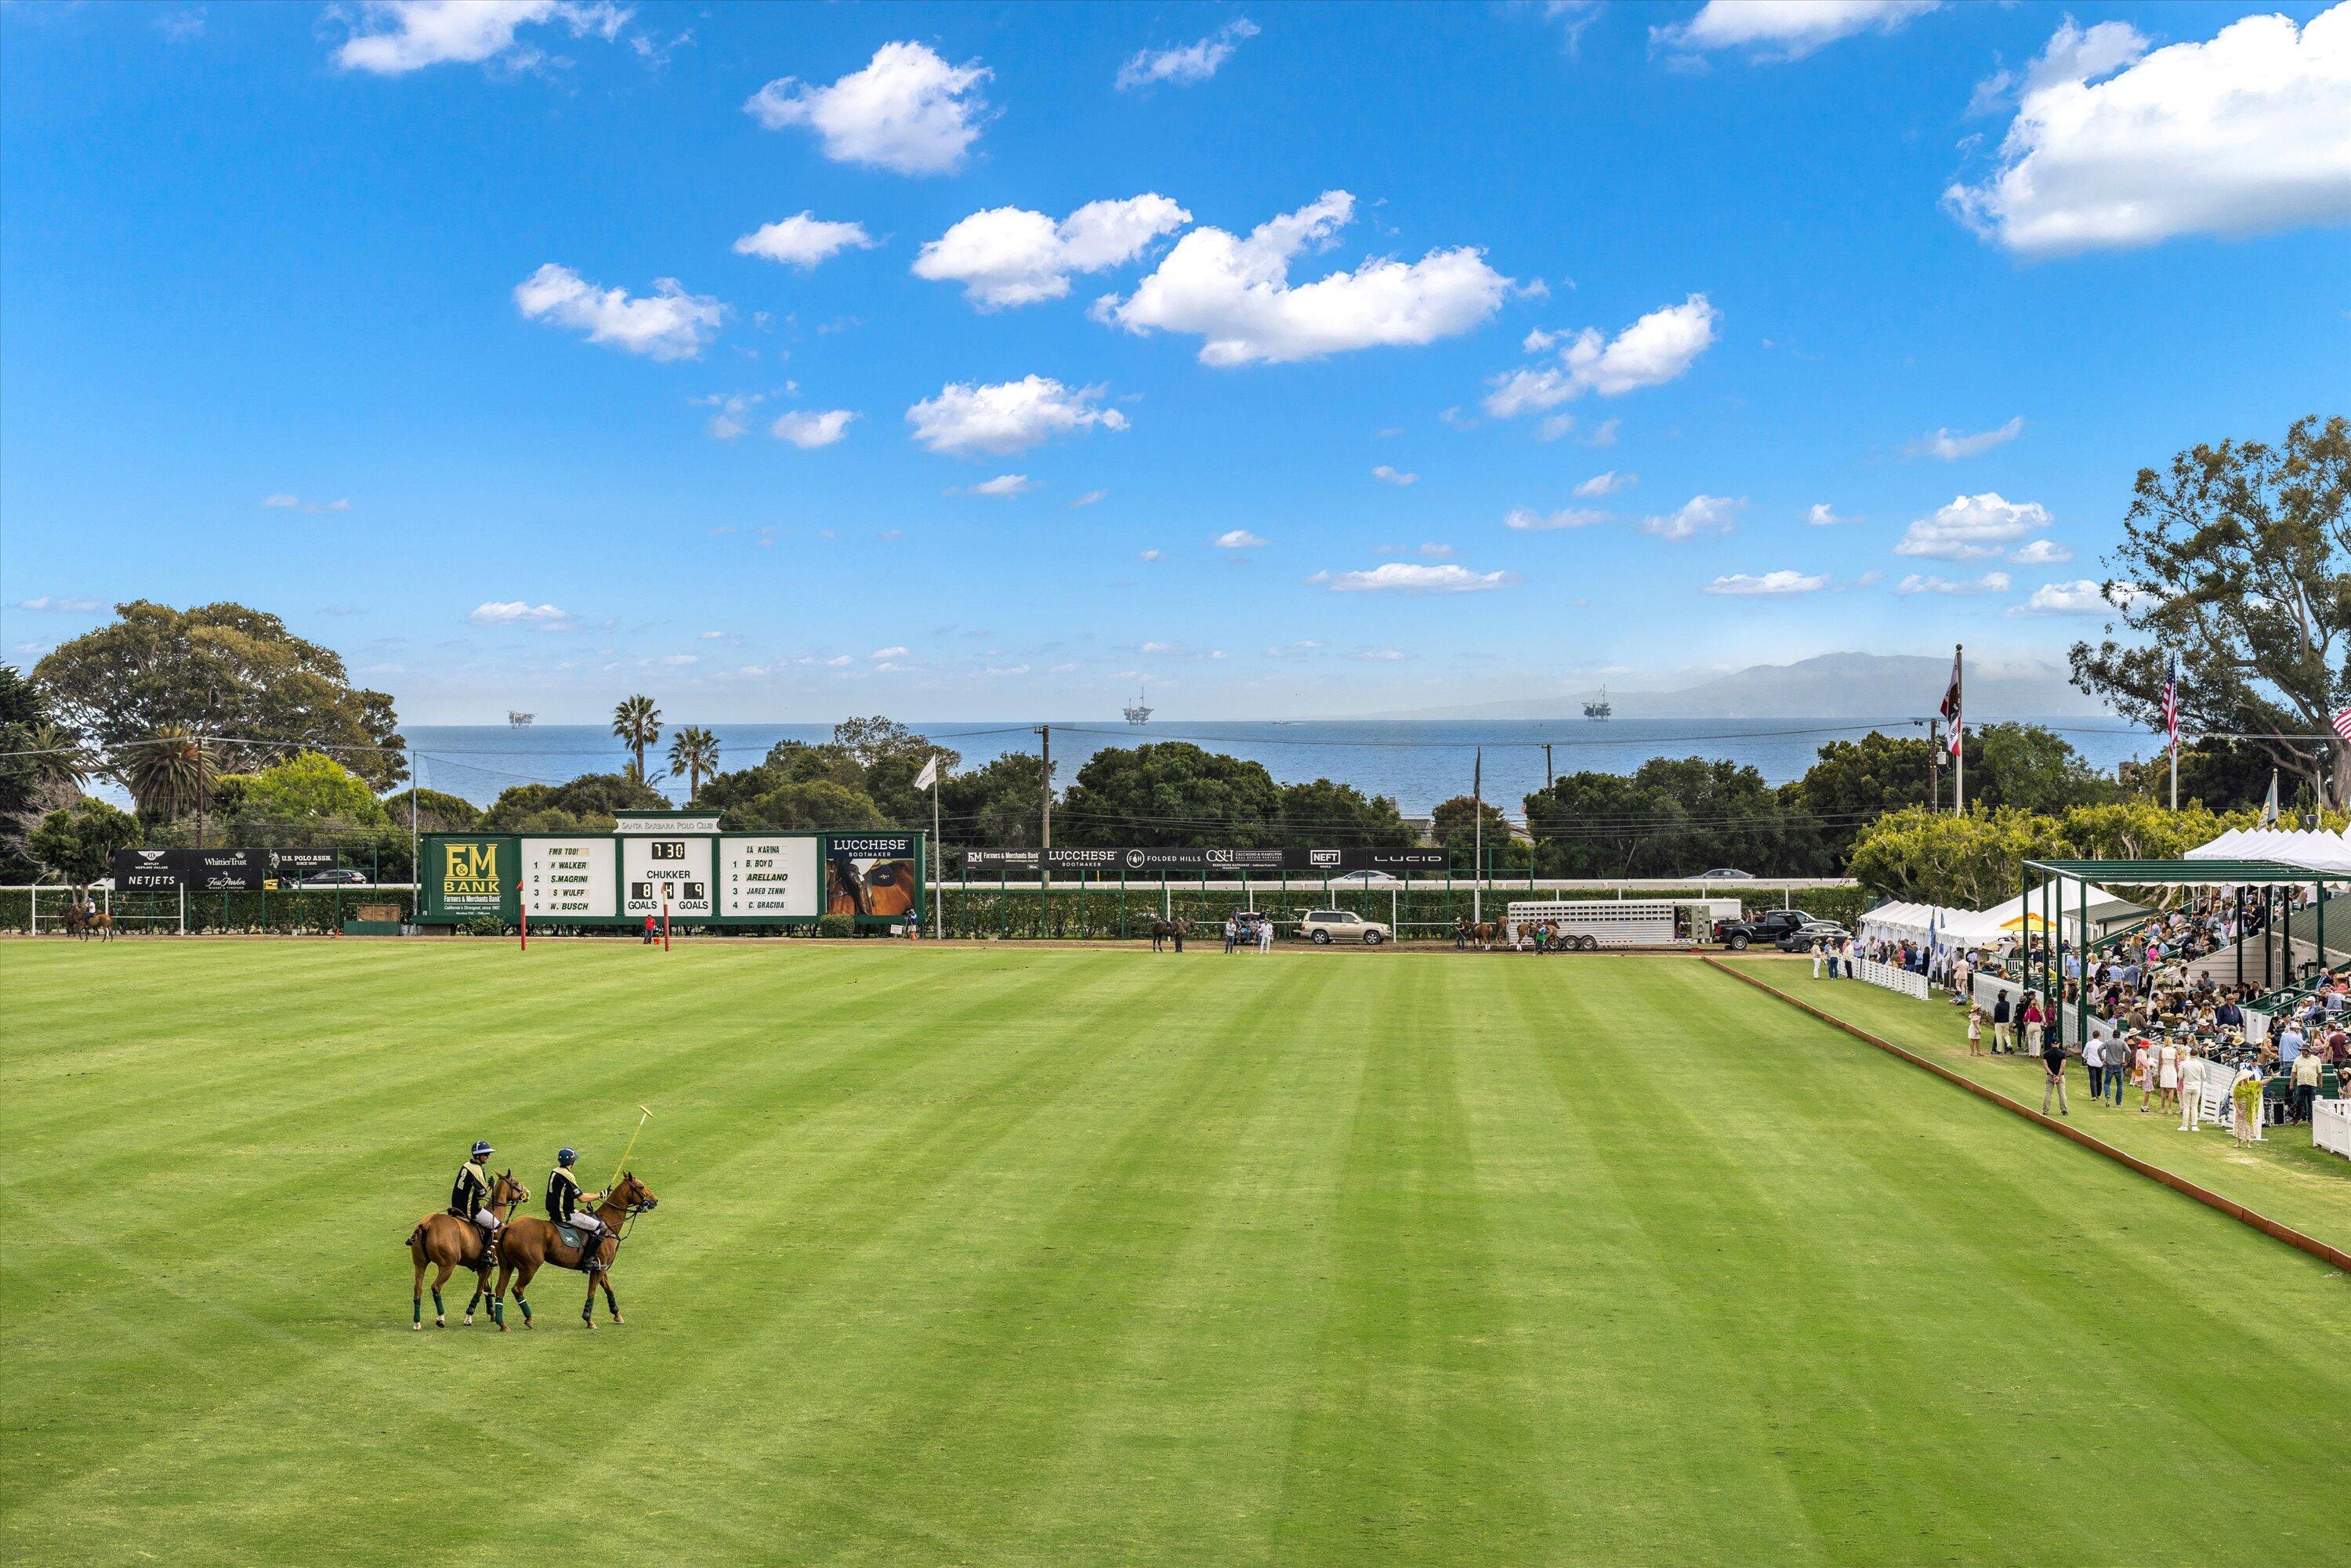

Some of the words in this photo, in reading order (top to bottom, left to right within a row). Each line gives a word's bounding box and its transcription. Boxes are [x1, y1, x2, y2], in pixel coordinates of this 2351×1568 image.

[444, 844, 498, 879] F&M
[1206, 849, 1233, 862] C&H
[129, 876, 175, 887] NETJETS
[444, 882, 500, 892] BANK
[643, 884, 651, 897] 8
[695, 884, 702, 896] 9
[458, 1168, 468, 1190] 2
[549, 1172, 556, 1193] 1
